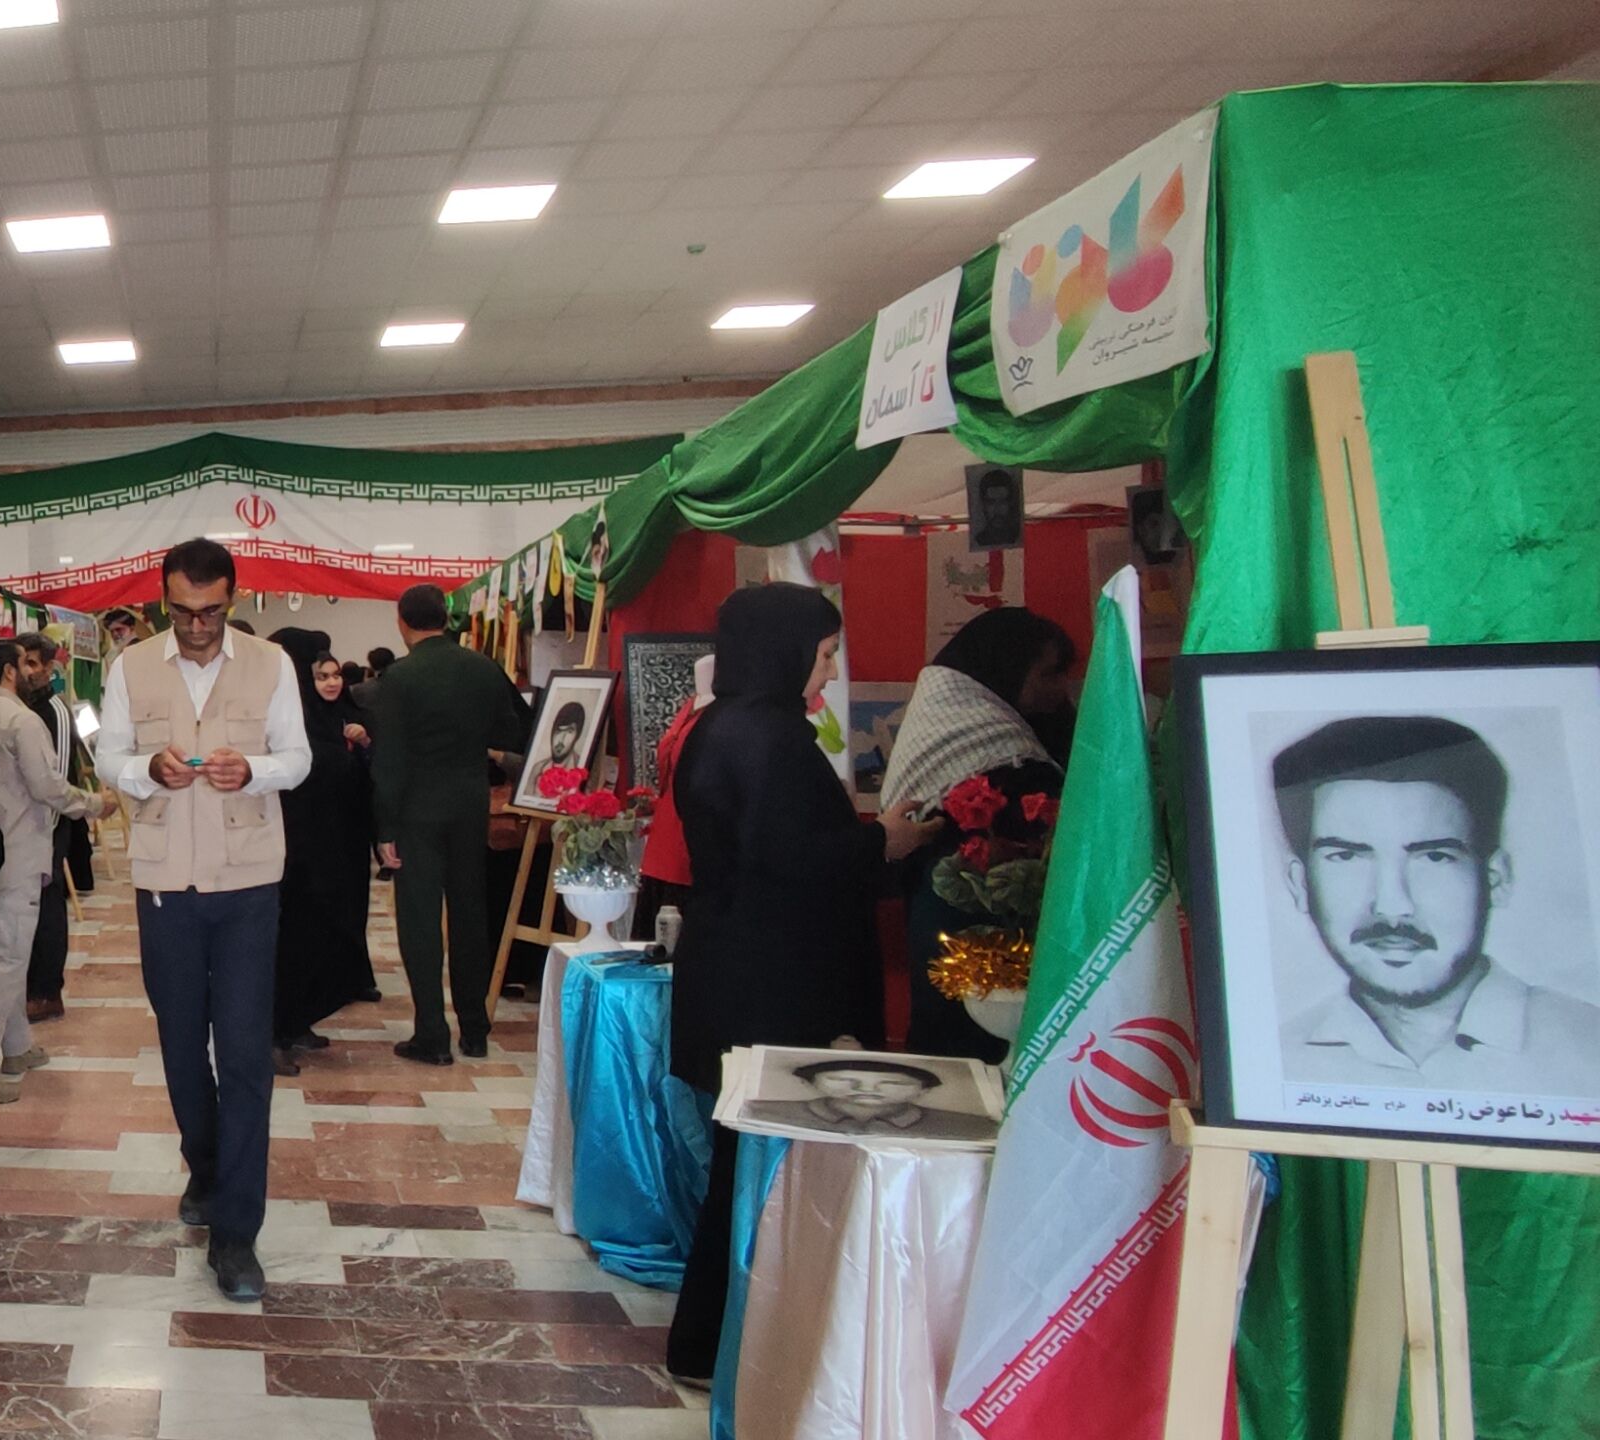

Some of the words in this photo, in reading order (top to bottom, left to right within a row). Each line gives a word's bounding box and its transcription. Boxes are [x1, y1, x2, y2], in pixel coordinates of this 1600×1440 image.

[1426, 1098, 1464, 1121] زاده
[1468, 1100, 1517, 1123] عوض
[1520, 1102, 1555, 1126] رضا
